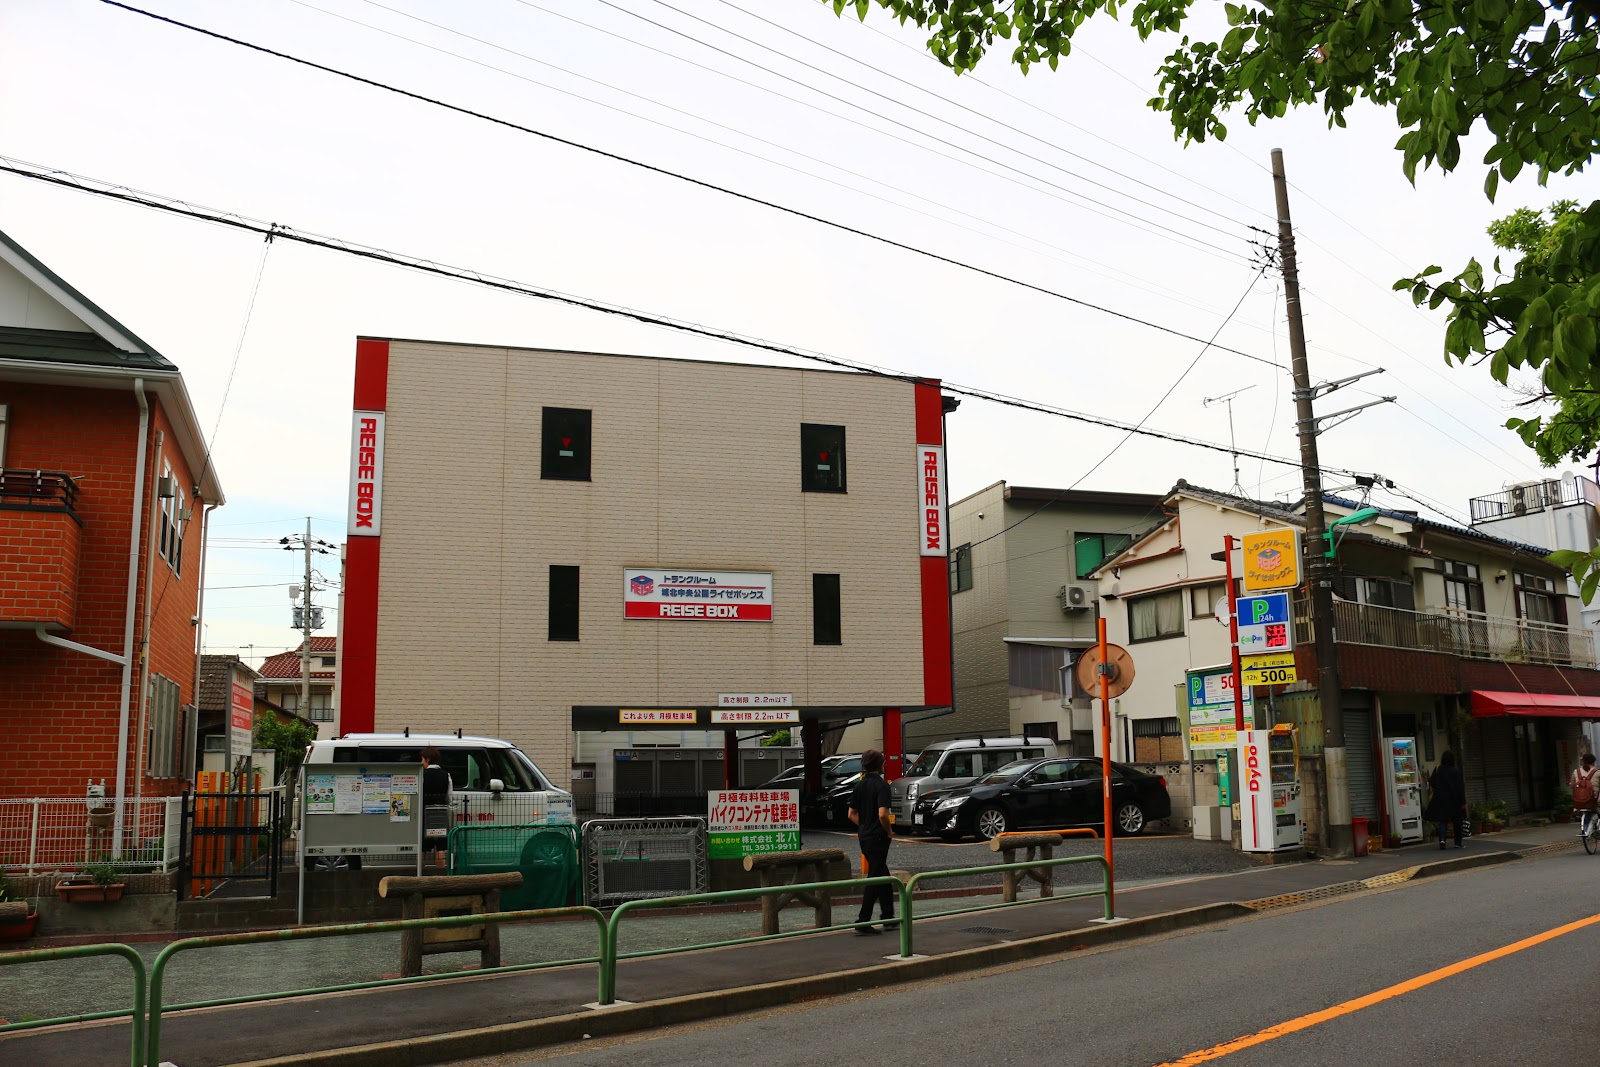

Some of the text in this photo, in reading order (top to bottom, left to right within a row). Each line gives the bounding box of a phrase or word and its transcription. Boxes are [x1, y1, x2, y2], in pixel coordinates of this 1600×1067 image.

[356, 418, 377, 528] REISE BOX
[924, 452, 940, 549] REISE BOX
[1257, 553, 1282, 571] REISE
[664, 575, 716, 585] トランクルーム
[630, 580, 654, 596] REISE
[661, 588, 764, 599] 城北中央公園ライゼボックス
[659, 604, 738, 617] REISE BOX
[1252, 600, 1269, 623] P
[1260, 614, 1274, 622] 24h
[1266, 625, 1286, 647] 満
[1221, 675, 1235, 689] 50
[1261, 669, 1294, 682] 500円
[1192, 677, 1202, 698] P
[659, 712, 693, 720] 月極駐車場
[721, 712, 752, 721] 高さ制限
[1248, 745, 1262, 791] DyDo
[718, 792, 790, 803] 月極有料駐車場
[710, 803, 797, 823] バイクコンテナ駐車場
[742, 835, 772, 844] 株式会社
[755, 843, 797, 851] 3931-9911
